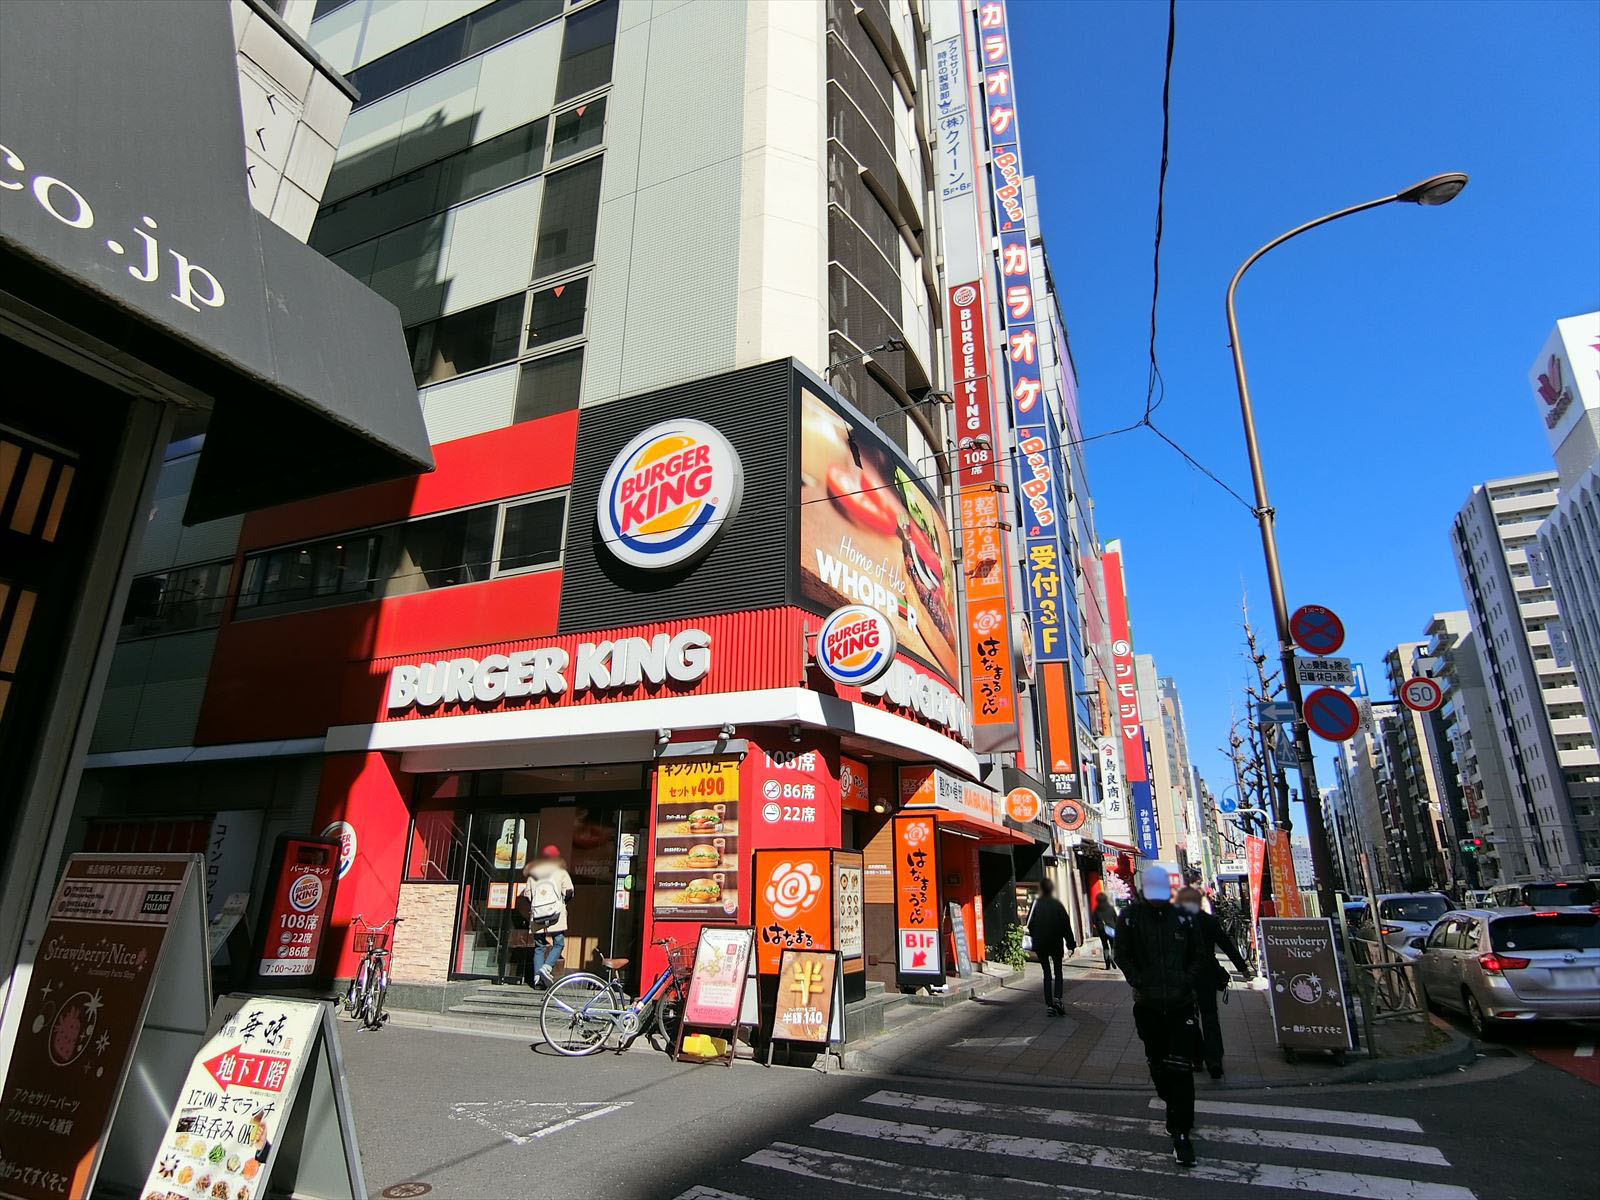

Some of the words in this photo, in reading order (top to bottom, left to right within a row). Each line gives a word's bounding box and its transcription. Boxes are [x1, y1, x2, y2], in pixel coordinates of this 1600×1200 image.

[947, 39, 958, 84] アクセサリー
[981, 3, 1013, 136] カラオケ
[1003, 243, 1041, 413] カラオケ
[960, 308, 976, 378] BURGER
[964, 381, 981, 430] KING
[964, 449, 988, 465] 108
[620, 445, 710, 504] BURGER
[620, 465, 712, 534] KING
[839, 535, 872, 575] Home
[875, 556, 889, 584] of
[888, 564, 906, 596] the
[827, 618, 877, 648] BURGER
[829, 630, 879, 666] KING
[388, 647, 569, 709] BURGER
[575, 629, 711, 691] KING
[977, 636, 1003, 715] はなまるうどん
[1115, 663, 1138, 739] シモジマ
[1409, 686, 1432, 702] 50
[764, 750, 816, 772] 108席
[669, 787, 690, 797] セット
[691, 777, 725, 796] ¥490
[783, 784, 816, 800] 86席
[783, 806, 816, 822] 22席
[290, 866, 330, 875] バーガーキング
[145, 893, 173, 902] PLEASE
[295, 888, 319, 902] KING
[907, 848, 930, 925] はなまるうどん
[143, 902, 169, 911] FOLLOW
[280, 914, 320, 930] 108席
[762, 922, 813, 947] はなまる
[292, 932, 313, 944] 22席
[1267, 934, 1328, 949] Strawberry
[289, 945, 310, 957] 86席
[1287, 946, 1313, 959] Nice
[216, 1054, 287, 1089] 地下1階
[12, 1088, 81, 1113] アクセサリーパーツ
[187, 1089, 218, 1106] 17:00
[218, 1093, 276, 1119] までランチ
[237, 1124, 255, 1145] OK
